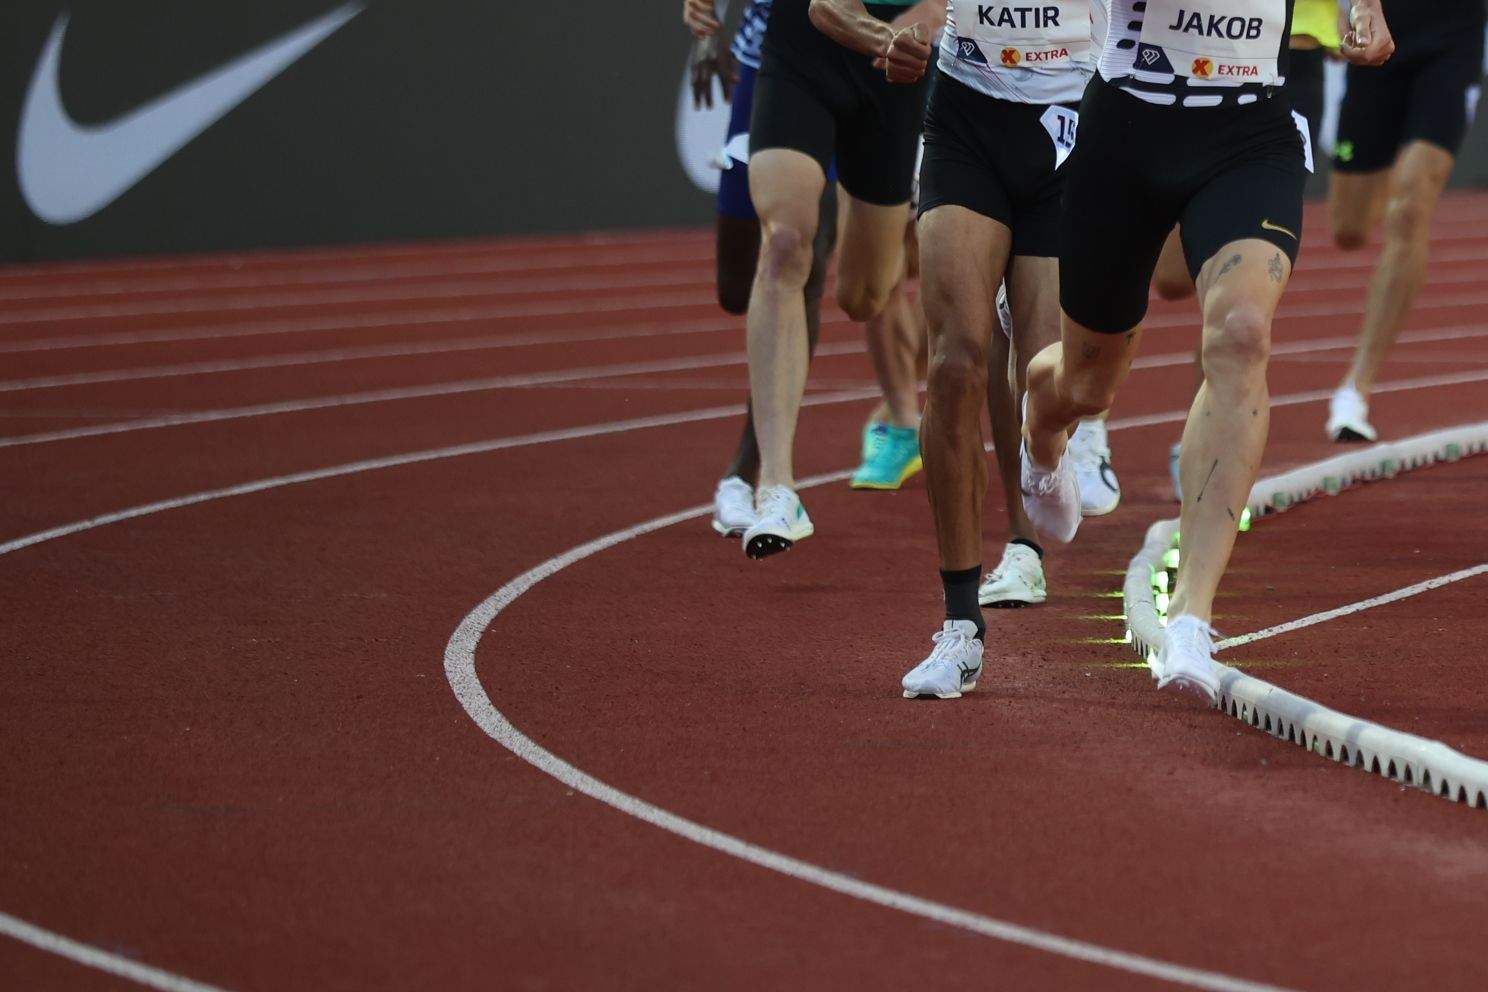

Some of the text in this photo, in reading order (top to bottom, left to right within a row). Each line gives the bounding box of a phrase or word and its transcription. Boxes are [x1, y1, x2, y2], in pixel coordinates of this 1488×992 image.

[978, 4, 1061, 29] KATIR
[1168, 9, 1263, 40] JAKOB
[1025, 48, 1069, 62] EXTRA
[1217, 64, 1259, 76] EXTRA
